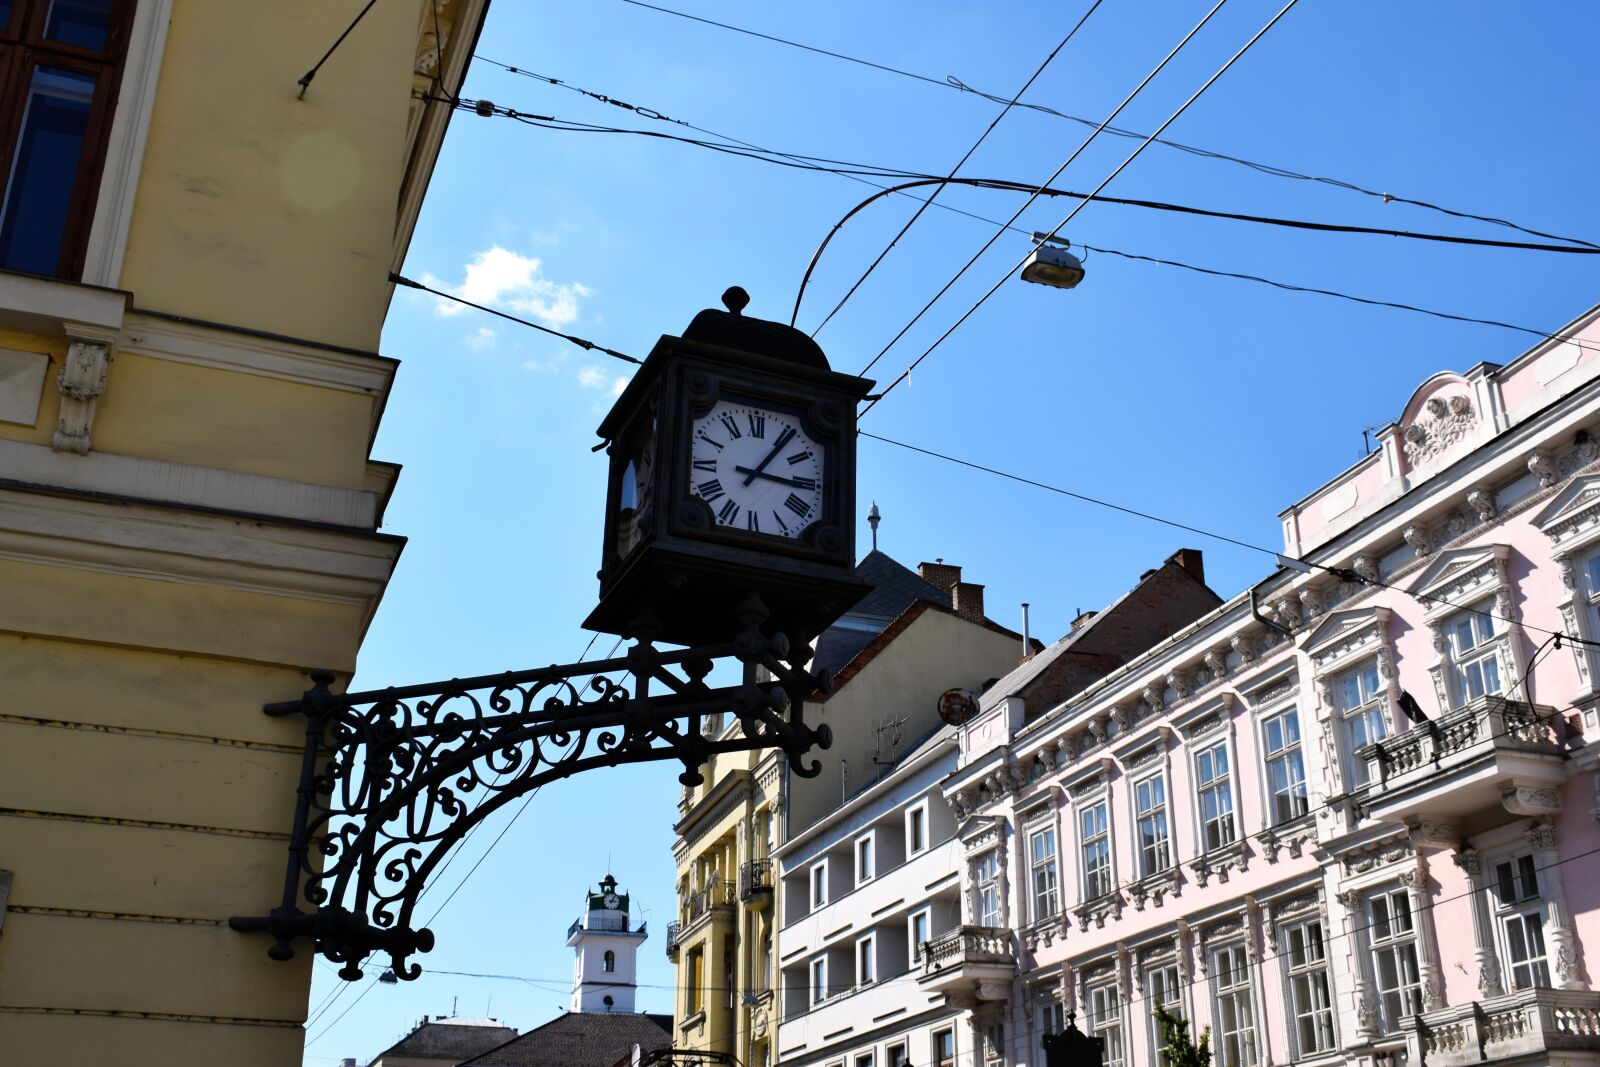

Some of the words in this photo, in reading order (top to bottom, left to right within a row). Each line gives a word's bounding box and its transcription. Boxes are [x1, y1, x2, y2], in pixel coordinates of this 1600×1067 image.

[721, 415, 742, 440] XI
[747, 414, 765, 439] XII
[700, 431, 725, 453] X
[786, 450, 810, 466] II
[773, 509, 788, 533] V
